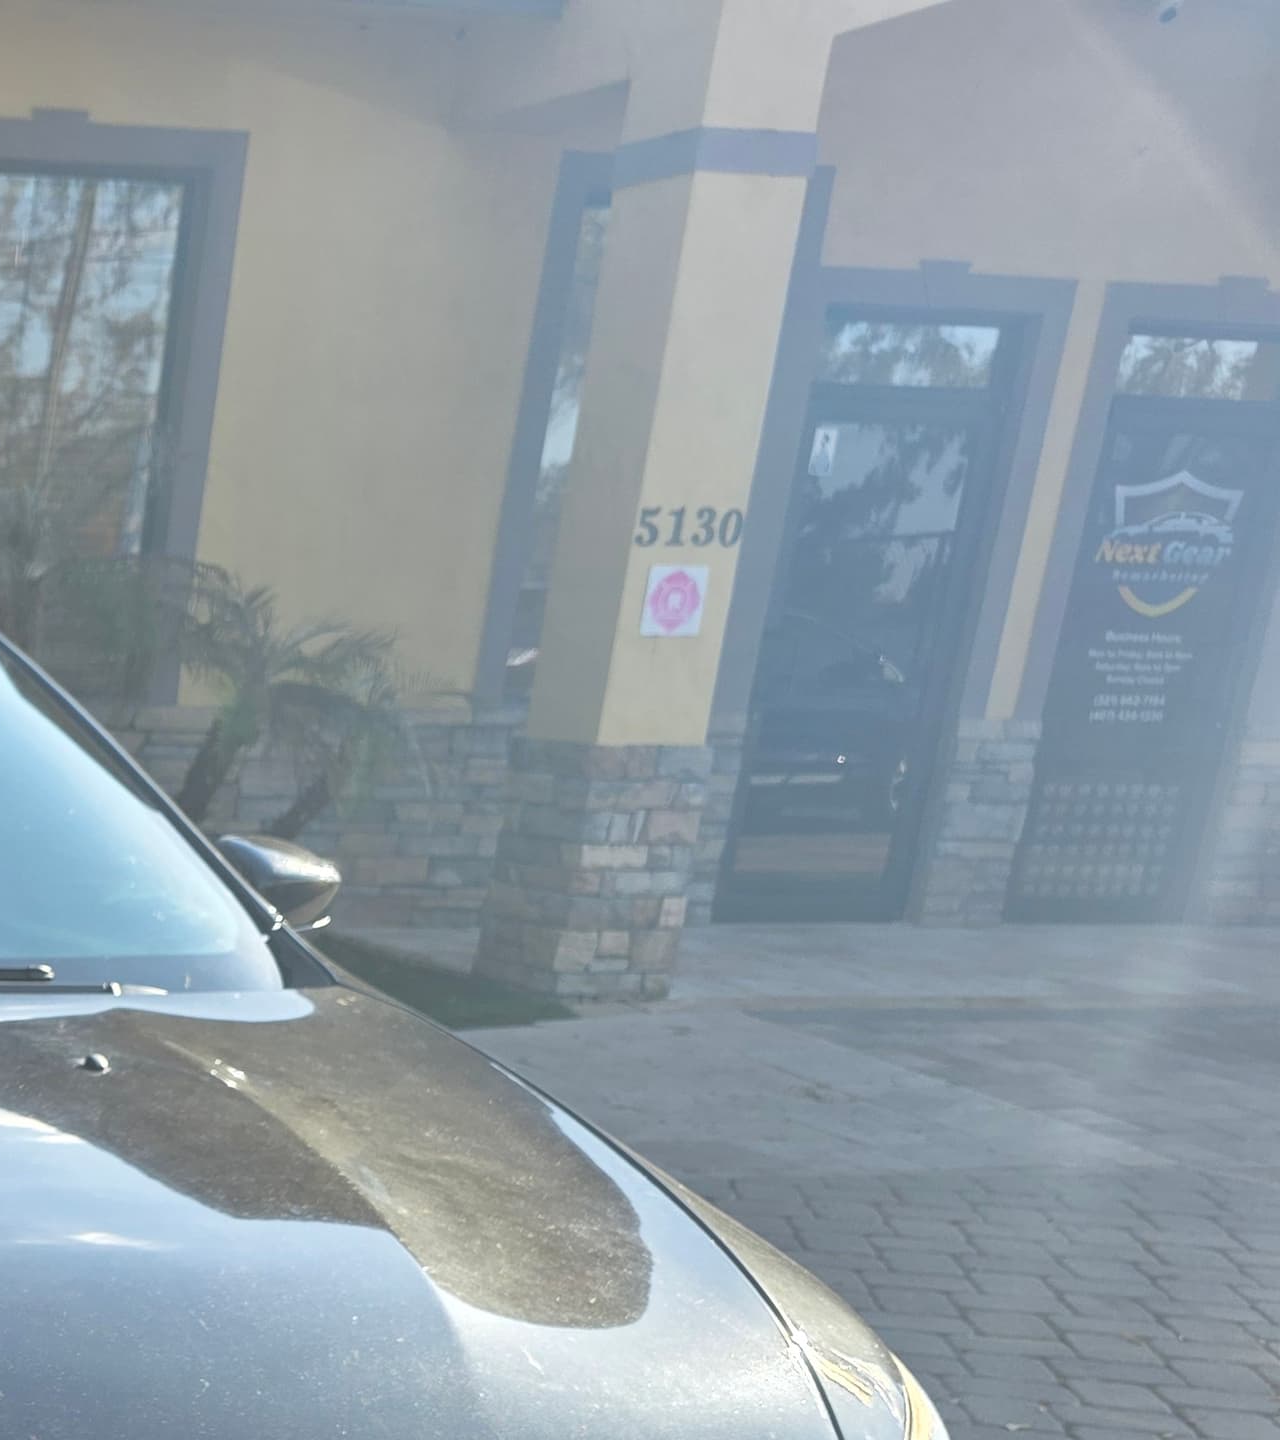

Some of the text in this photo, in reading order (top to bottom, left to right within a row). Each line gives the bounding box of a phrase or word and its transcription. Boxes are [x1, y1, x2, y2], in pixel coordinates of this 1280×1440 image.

[634, 505, 744, 548] 5130
[1094, 538, 1232, 566] Next Gear
